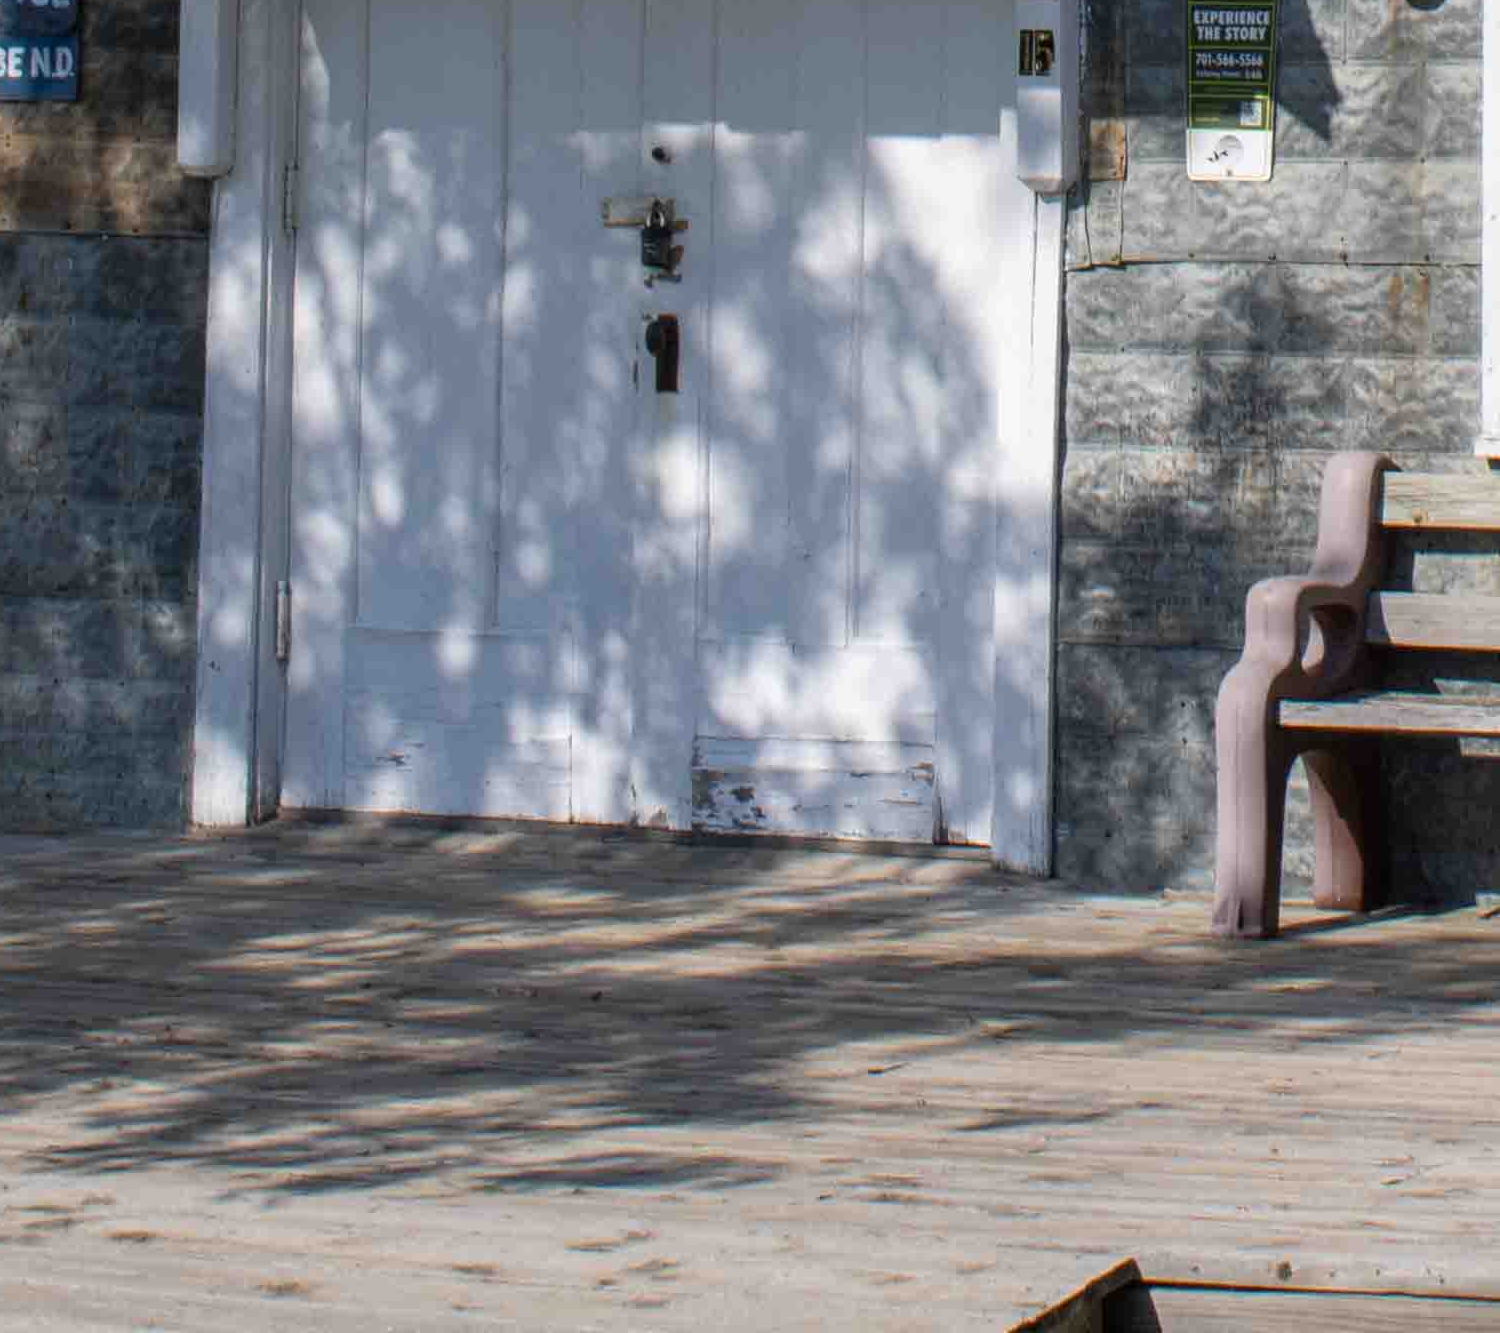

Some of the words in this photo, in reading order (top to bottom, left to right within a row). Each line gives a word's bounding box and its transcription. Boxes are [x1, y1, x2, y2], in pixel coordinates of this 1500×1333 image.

[1193, 9, 1269, 25] EXPERIENCE
[1197, 26, 1221, 41] THE
[1224, 26, 1267, 41] STORY
